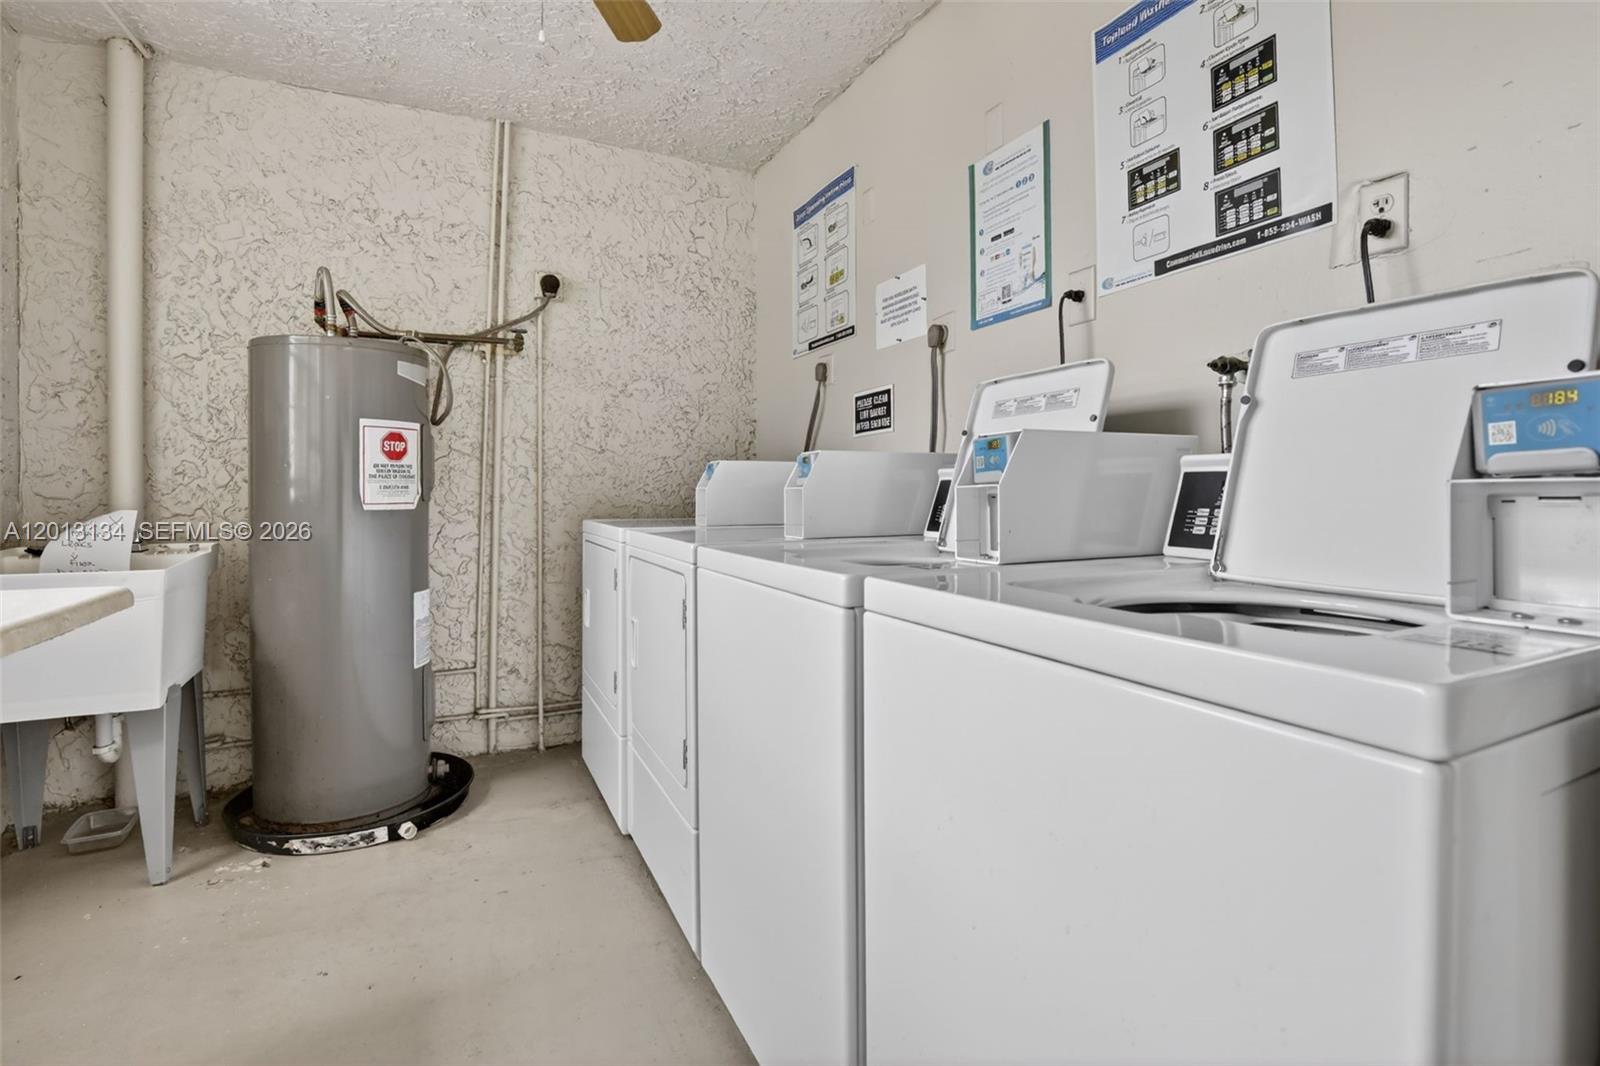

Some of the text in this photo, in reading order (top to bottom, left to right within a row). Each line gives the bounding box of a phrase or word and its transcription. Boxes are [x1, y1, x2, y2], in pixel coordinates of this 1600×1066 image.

[1200, 5, 1206, 15] 2
[1102, 16, 1138, 47] Topload
[1202, 121, 1209, 132] 6
[1119, 160, 1125, 171] 5
[1203, 181, 1210, 191] 8
[1121, 215, 1126, 225] 7
[383, 440, 406, 453] STOP
